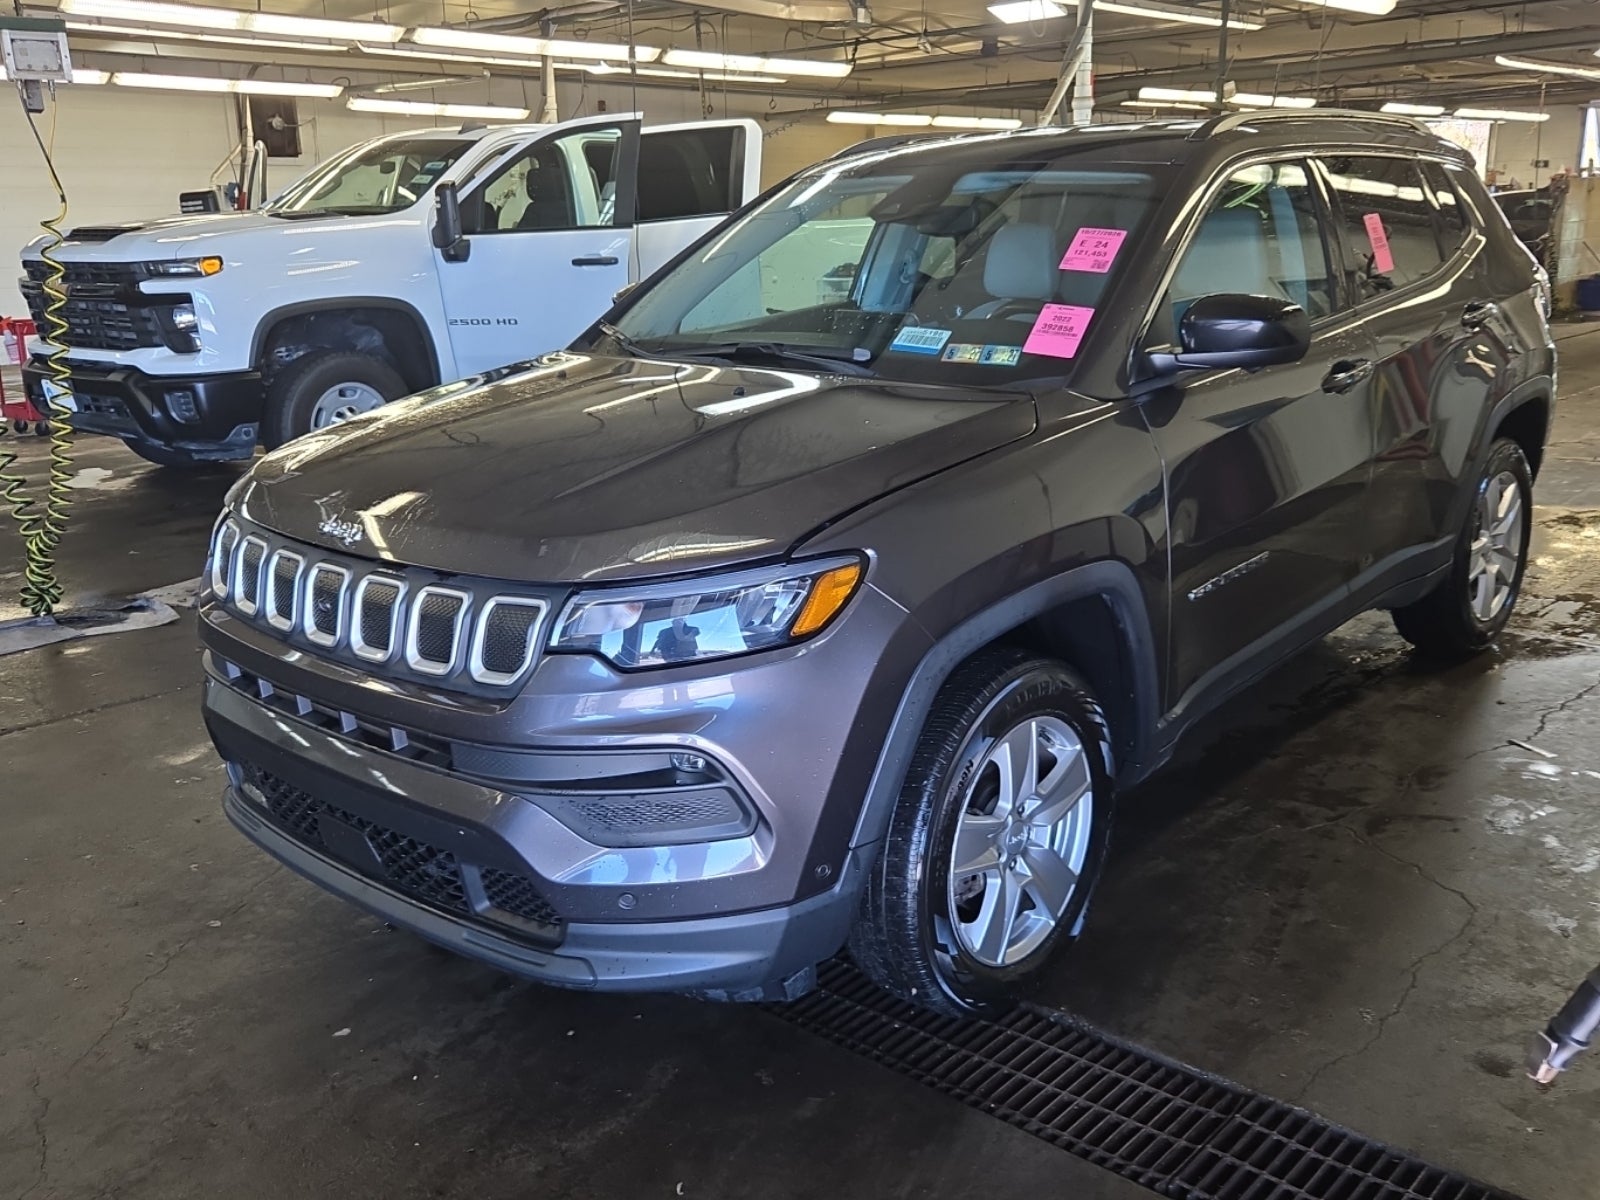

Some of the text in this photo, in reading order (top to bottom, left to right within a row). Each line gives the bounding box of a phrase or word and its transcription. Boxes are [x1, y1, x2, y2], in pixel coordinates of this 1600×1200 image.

[1093, 240, 1109, 248] 24
[448, 318, 518, 326] 2500 HD
